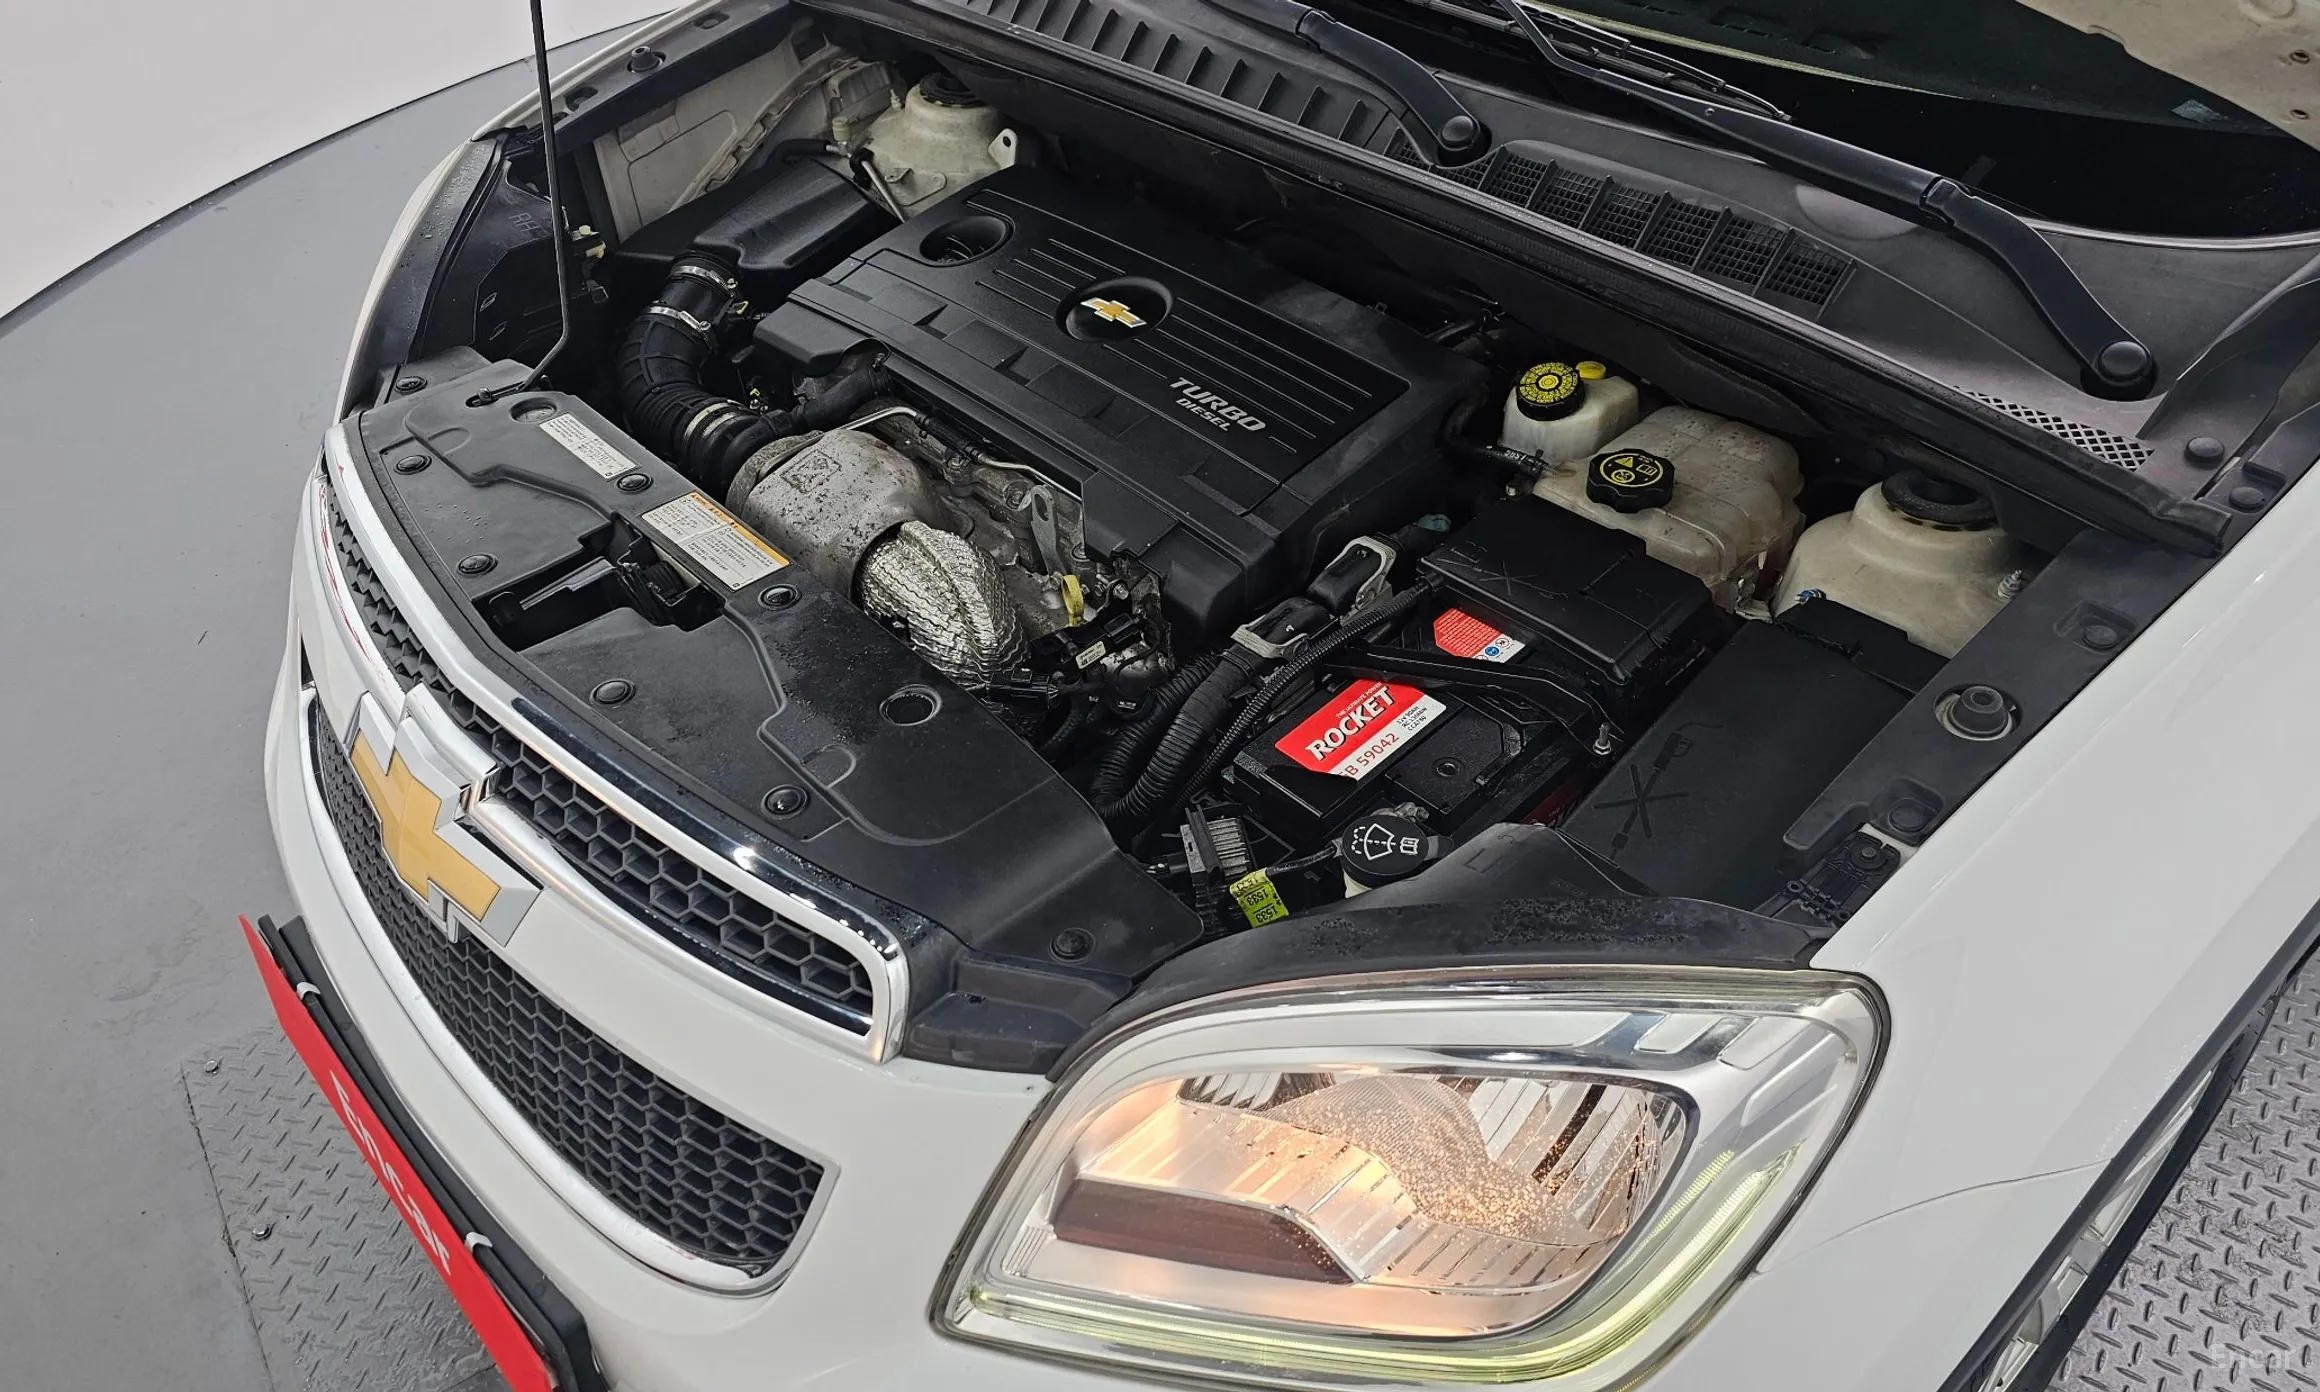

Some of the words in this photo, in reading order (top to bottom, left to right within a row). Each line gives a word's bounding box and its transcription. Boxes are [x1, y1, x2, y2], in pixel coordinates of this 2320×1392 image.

[1169, 376, 1266, 431] TURBO
[1175, 398, 1230, 431] DIESEL
[1304, 685, 1395, 760] ROCKET
[1356, 732, 1400, 767] 59042
[1246, 889, 1268, 906] 1533
[1255, 905, 1278, 923] 1533
